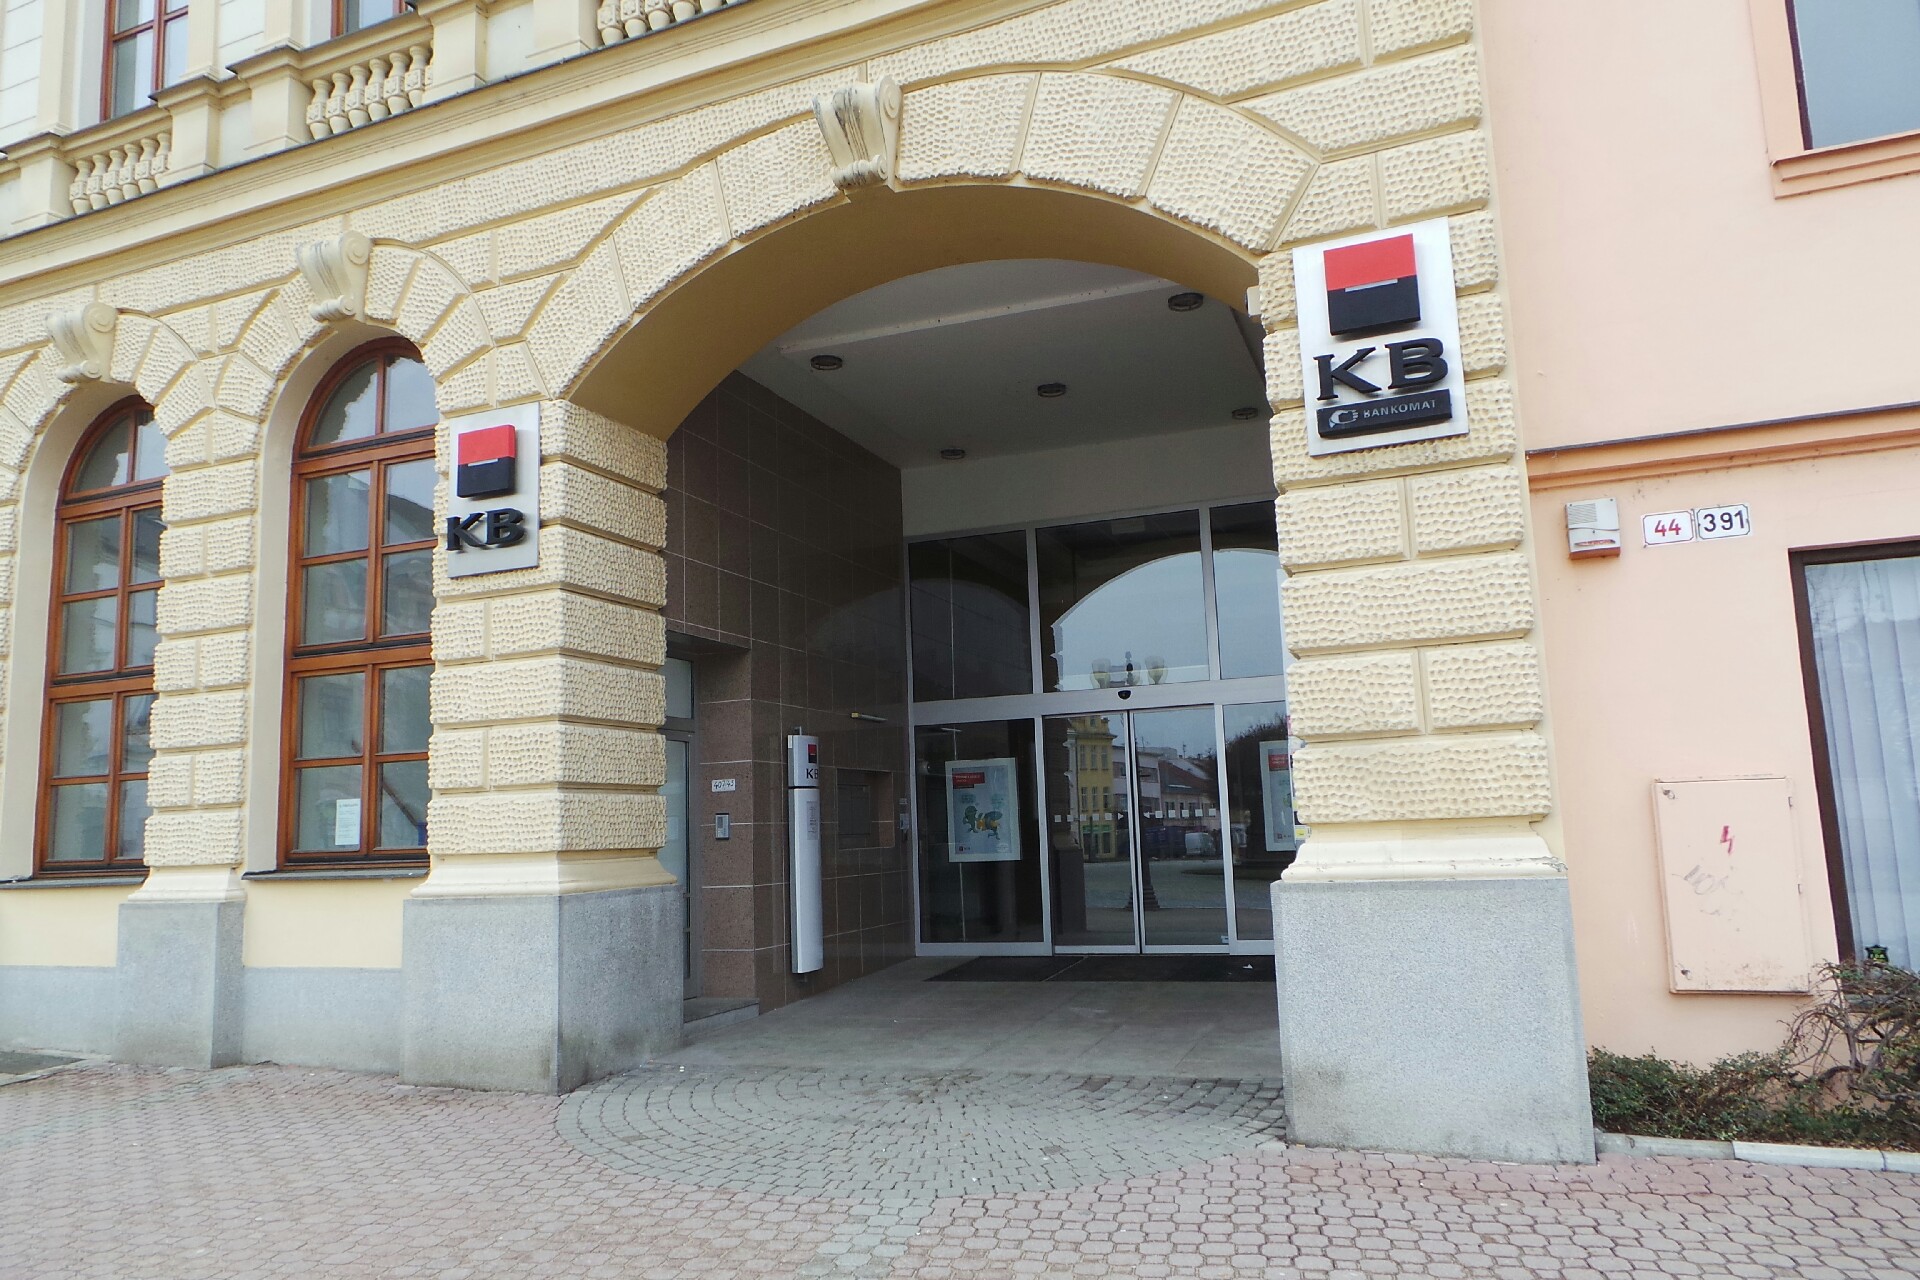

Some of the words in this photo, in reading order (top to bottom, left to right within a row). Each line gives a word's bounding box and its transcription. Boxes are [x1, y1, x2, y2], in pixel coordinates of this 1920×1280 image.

[1313, 337, 1448, 400] KB
[1363, 399, 1437, 419] BANKOMAT
[445, 508, 525, 551] KB
[1654, 519, 1681, 536] 44
[1703, 510, 1744, 532] 391
[806, 768, 818, 779] KB
